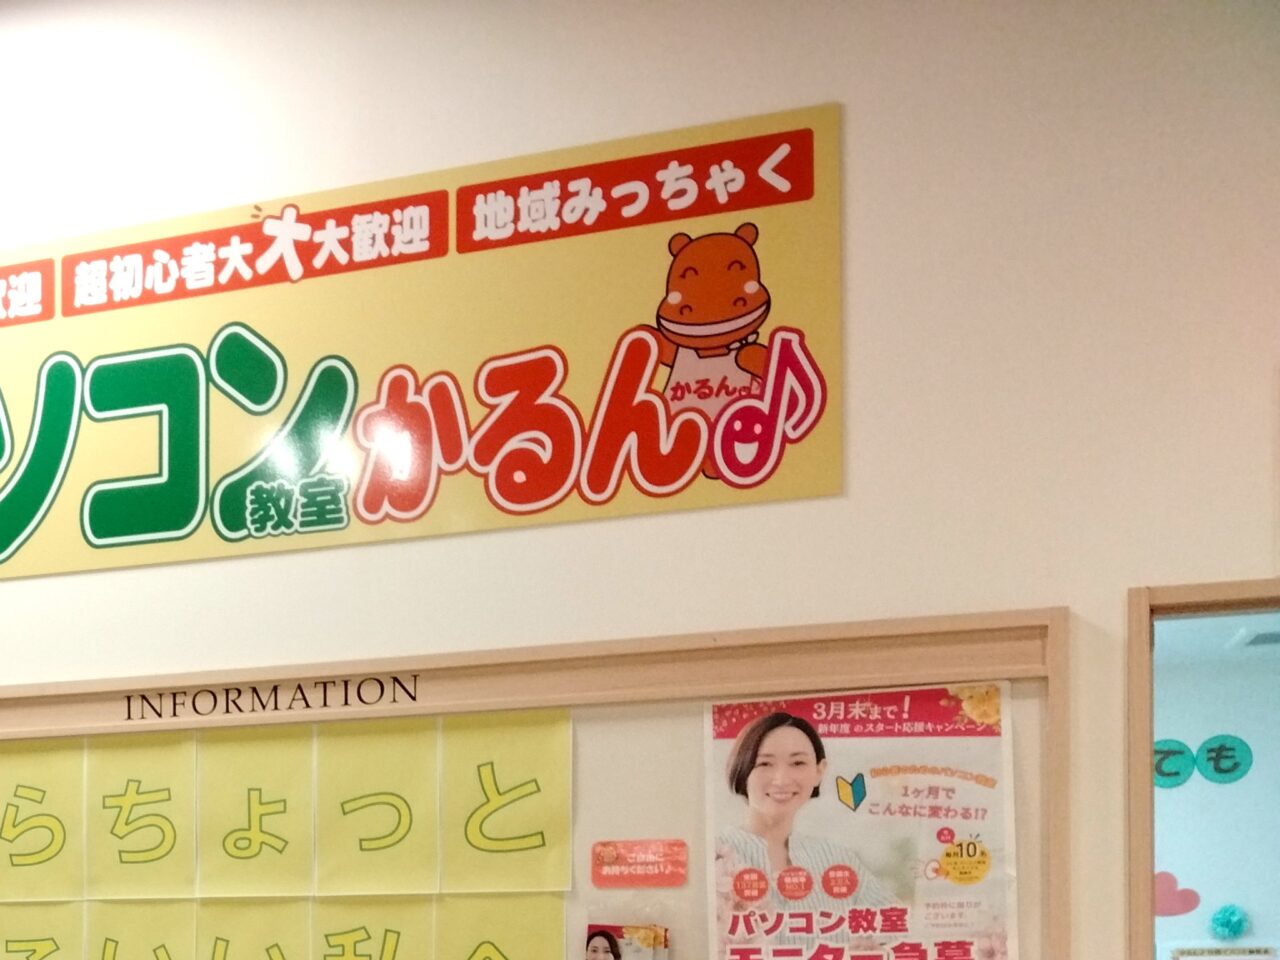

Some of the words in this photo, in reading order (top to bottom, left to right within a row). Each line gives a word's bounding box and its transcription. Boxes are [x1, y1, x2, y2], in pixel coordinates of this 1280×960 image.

[473, 143, 791, 241] 地域みっちゃく
[246, 474, 350, 537] 教室
[124, 674, 420, 721] INFORMATION
[728, 906, 909, 937] パソコン教室
